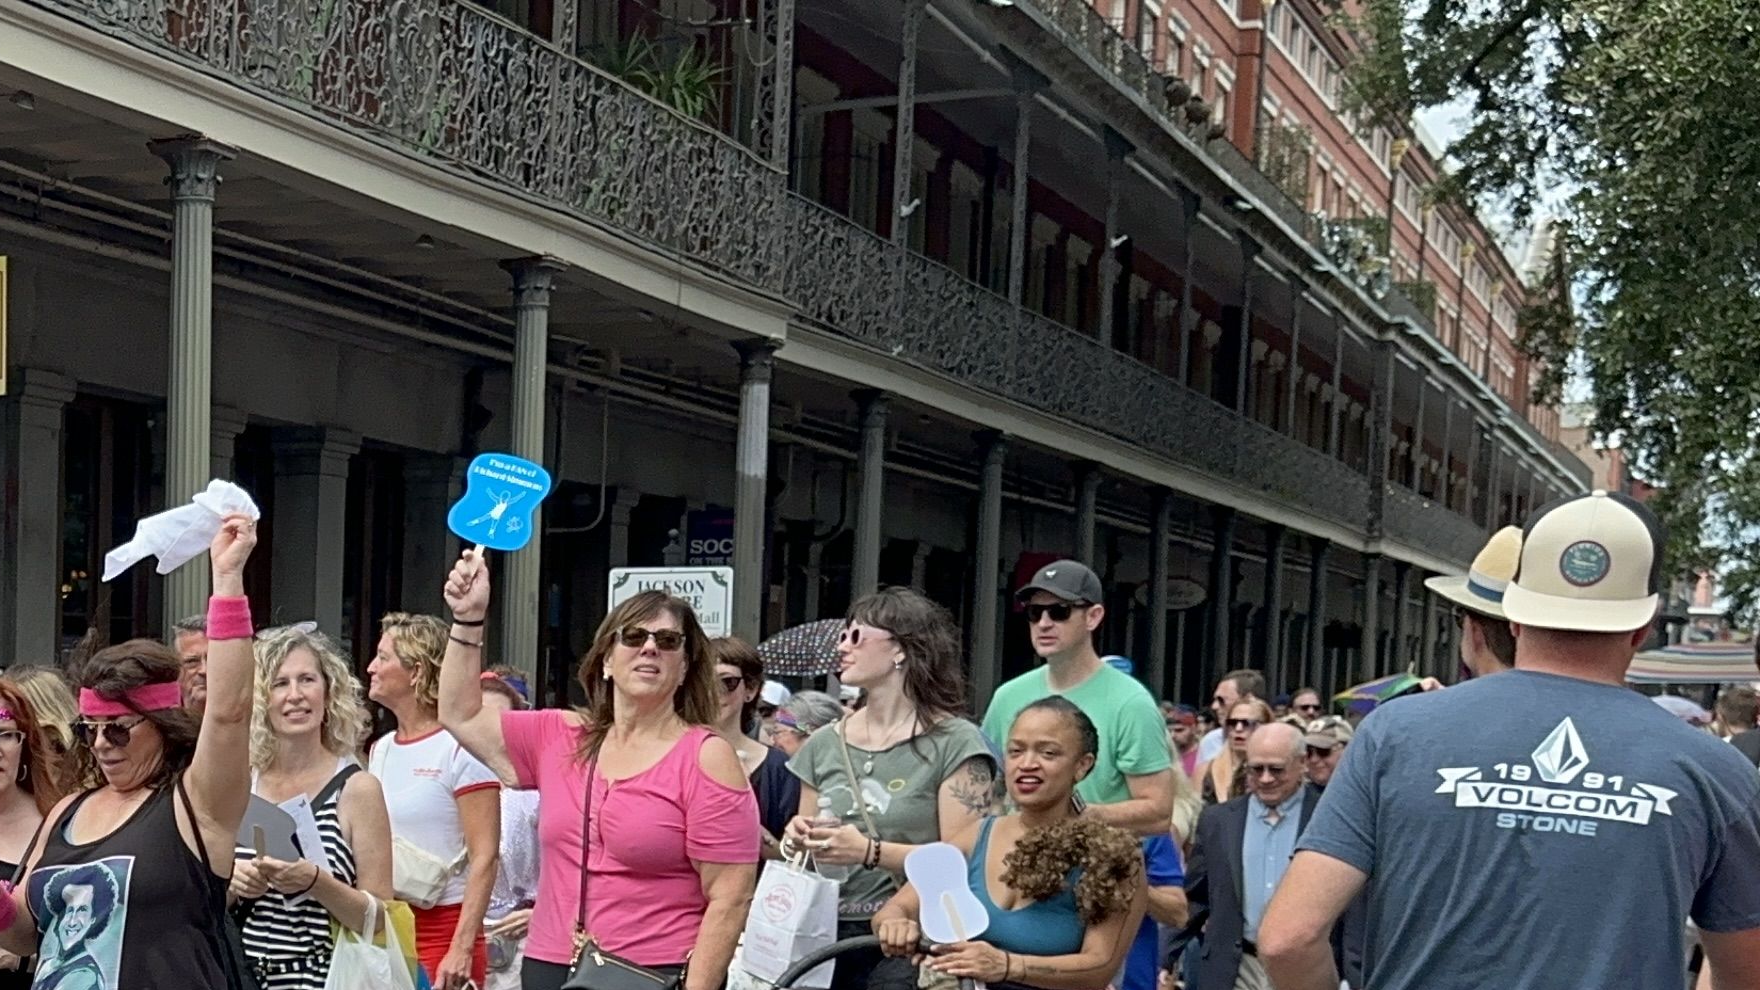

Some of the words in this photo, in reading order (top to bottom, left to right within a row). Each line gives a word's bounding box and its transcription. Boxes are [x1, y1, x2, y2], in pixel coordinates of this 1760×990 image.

[637, 579, 705, 594] JACKSON
[1471, 785, 1639, 819] VOLCOM
[1496, 812, 1599, 837] STONE
[838, 900, 884, 914] emor
